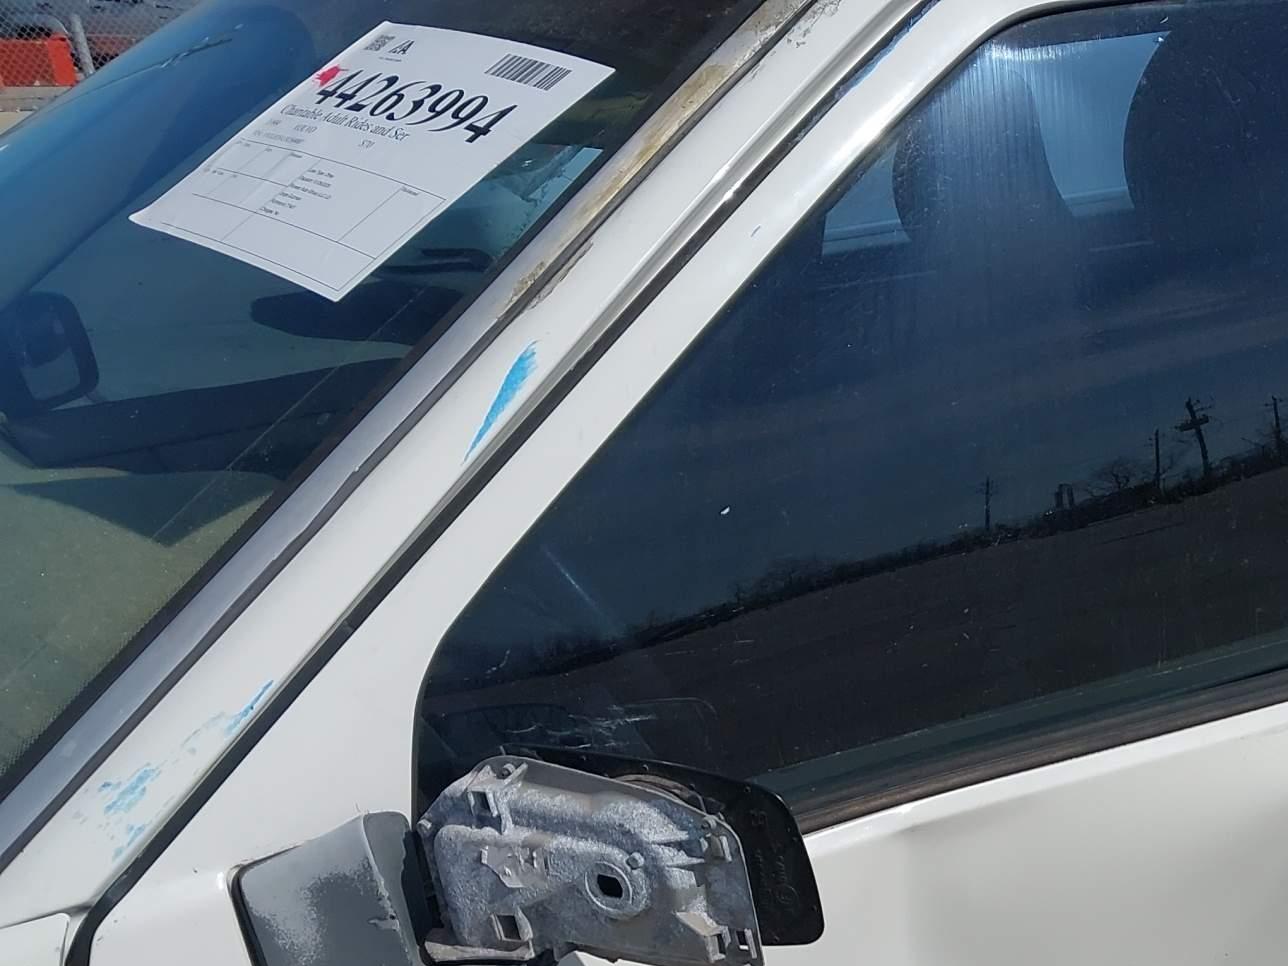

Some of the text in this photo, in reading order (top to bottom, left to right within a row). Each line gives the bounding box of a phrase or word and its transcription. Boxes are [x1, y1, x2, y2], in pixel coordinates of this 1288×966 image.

[315, 69, 518, 143] 44263994
[322, 112, 348, 126] Adult
[344, 116, 371, 132] Rides
[370, 122, 394, 137] and
[388, 127, 411, 141] Ser
